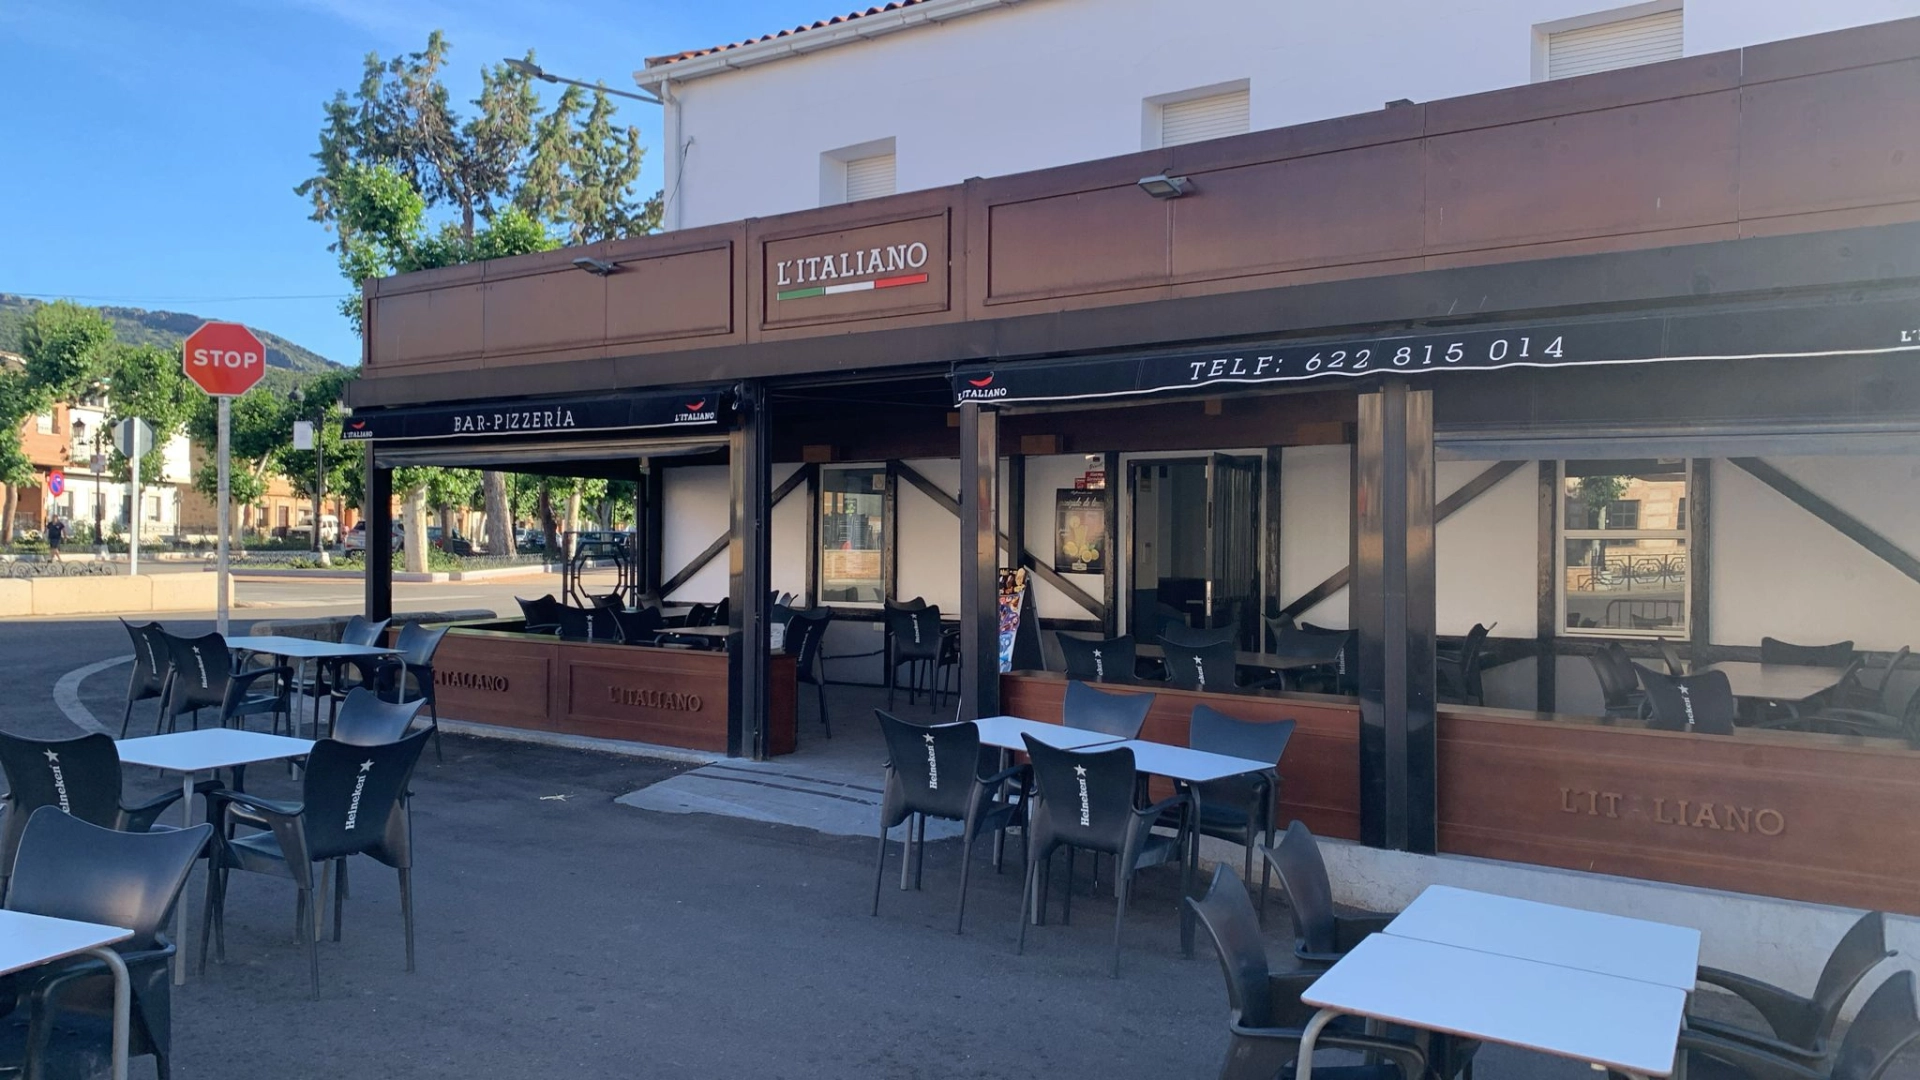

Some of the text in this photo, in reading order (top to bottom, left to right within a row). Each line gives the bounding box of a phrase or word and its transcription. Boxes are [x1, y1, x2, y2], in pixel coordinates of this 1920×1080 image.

[193, 349, 258, 369] STOP
[1190, 337, 1564, 381] TELF: 622 815 014
[454, 406, 575, 432] BAR-PIZZERÍA
[49, 764, 70, 814] eineken
[925, 744, 938, 790] Heineken
[345, 775, 367, 831] Heineken
[1076, 777, 1090, 827] Heineken
